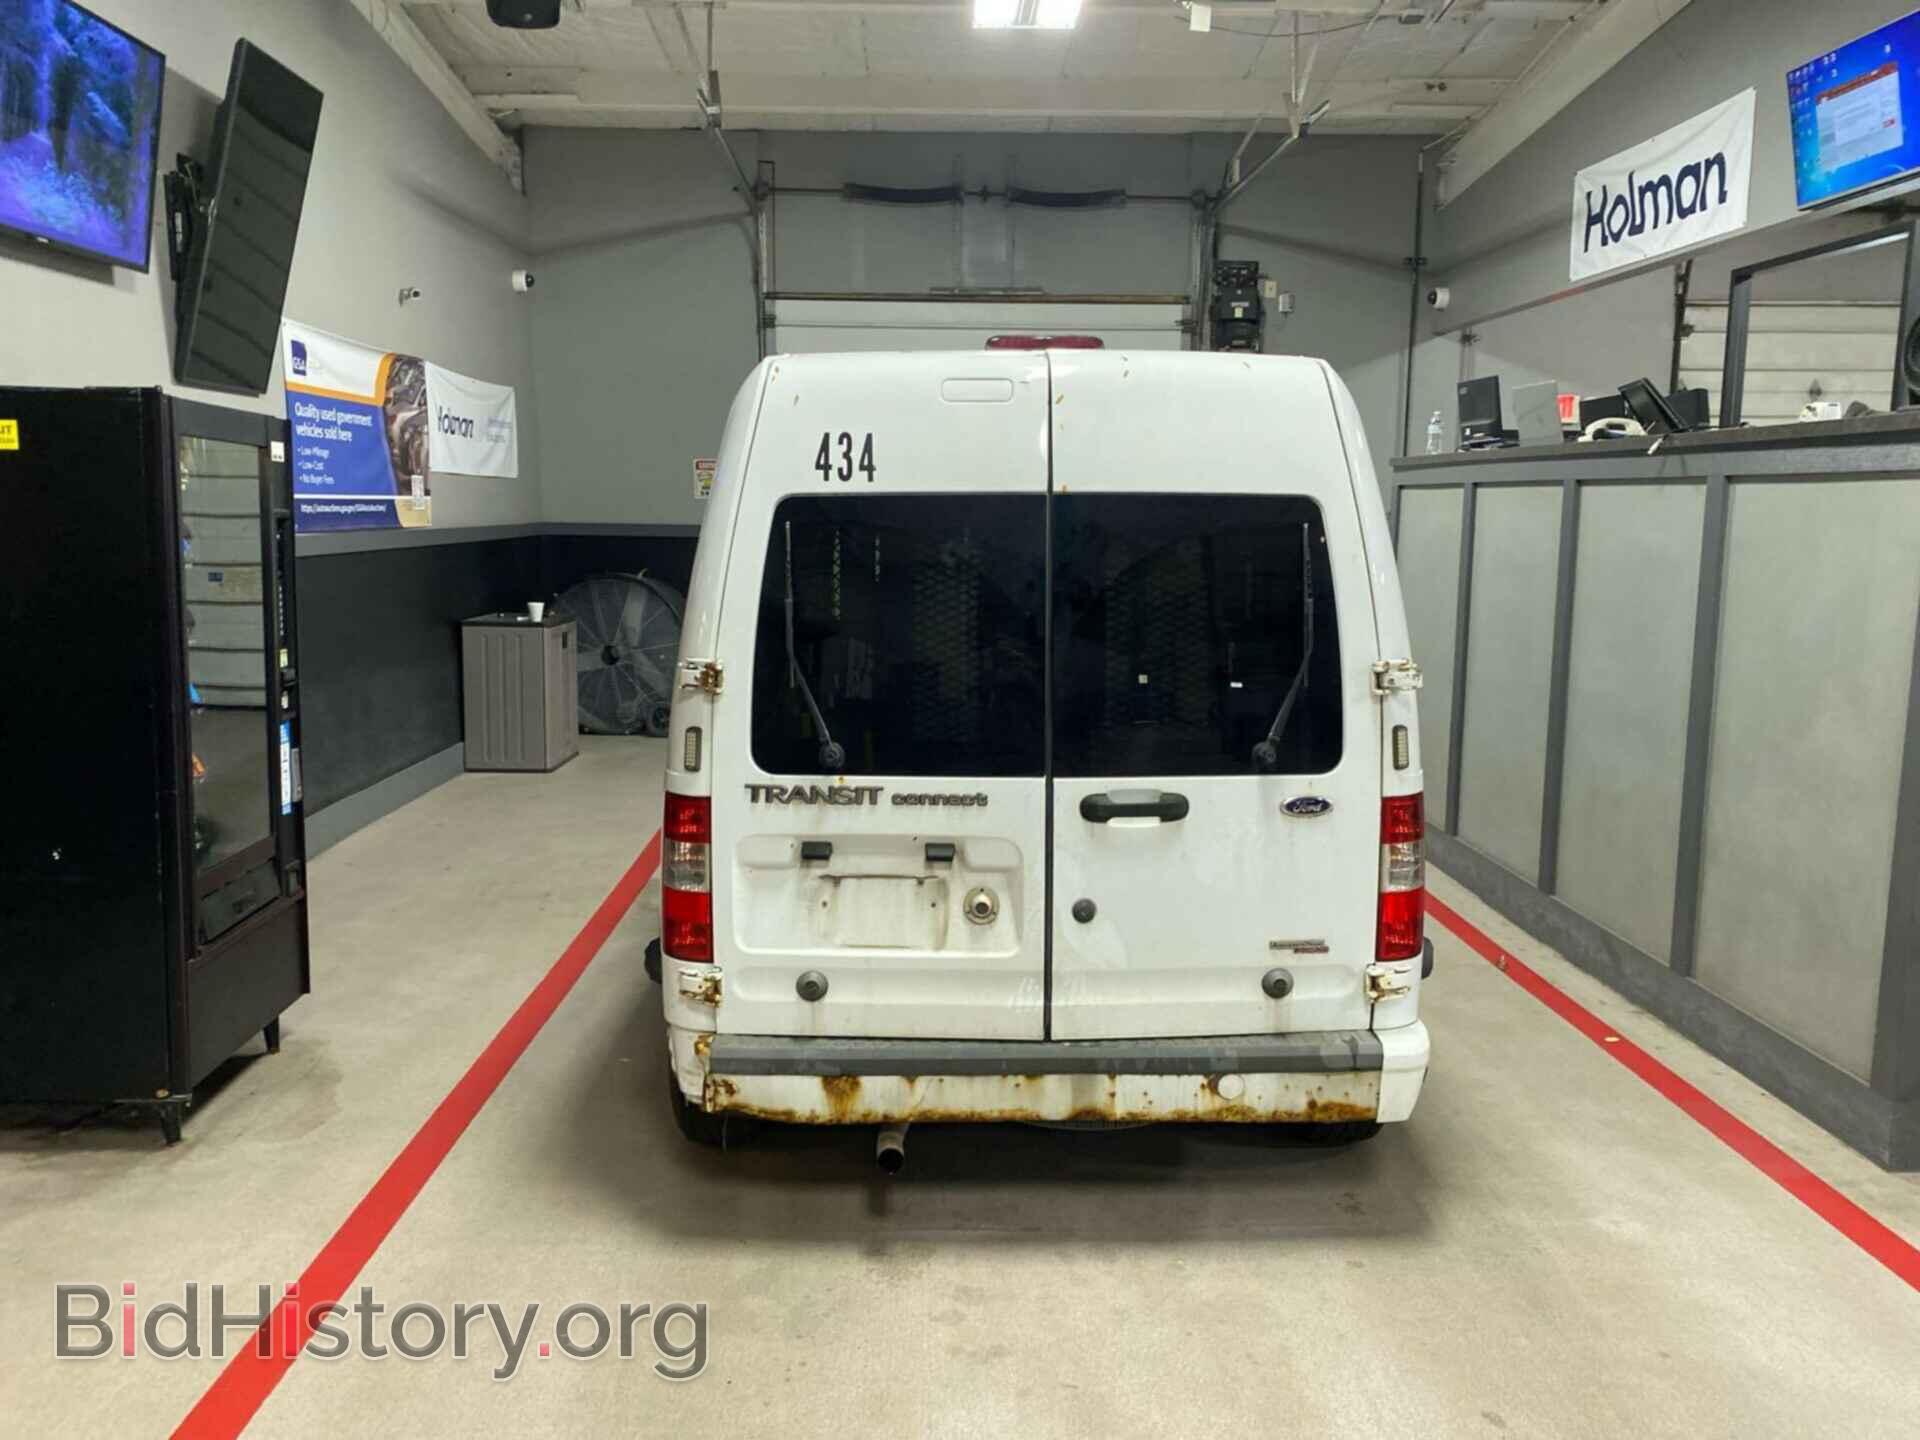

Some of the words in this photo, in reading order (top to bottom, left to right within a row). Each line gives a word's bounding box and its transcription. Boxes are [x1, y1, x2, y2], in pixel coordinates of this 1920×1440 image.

[1584, 151, 1728, 253] Holman
[295, 401, 320, 423] Quality
[320, 408, 337, 421] used
[296, 421, 324, 439] vehicles
[324, 426, 337, 439] sold
[815, 432, 876, 482] 434
[744, 784, 884, 806] TRANSIT
[891, 792, 988, 807] connect
